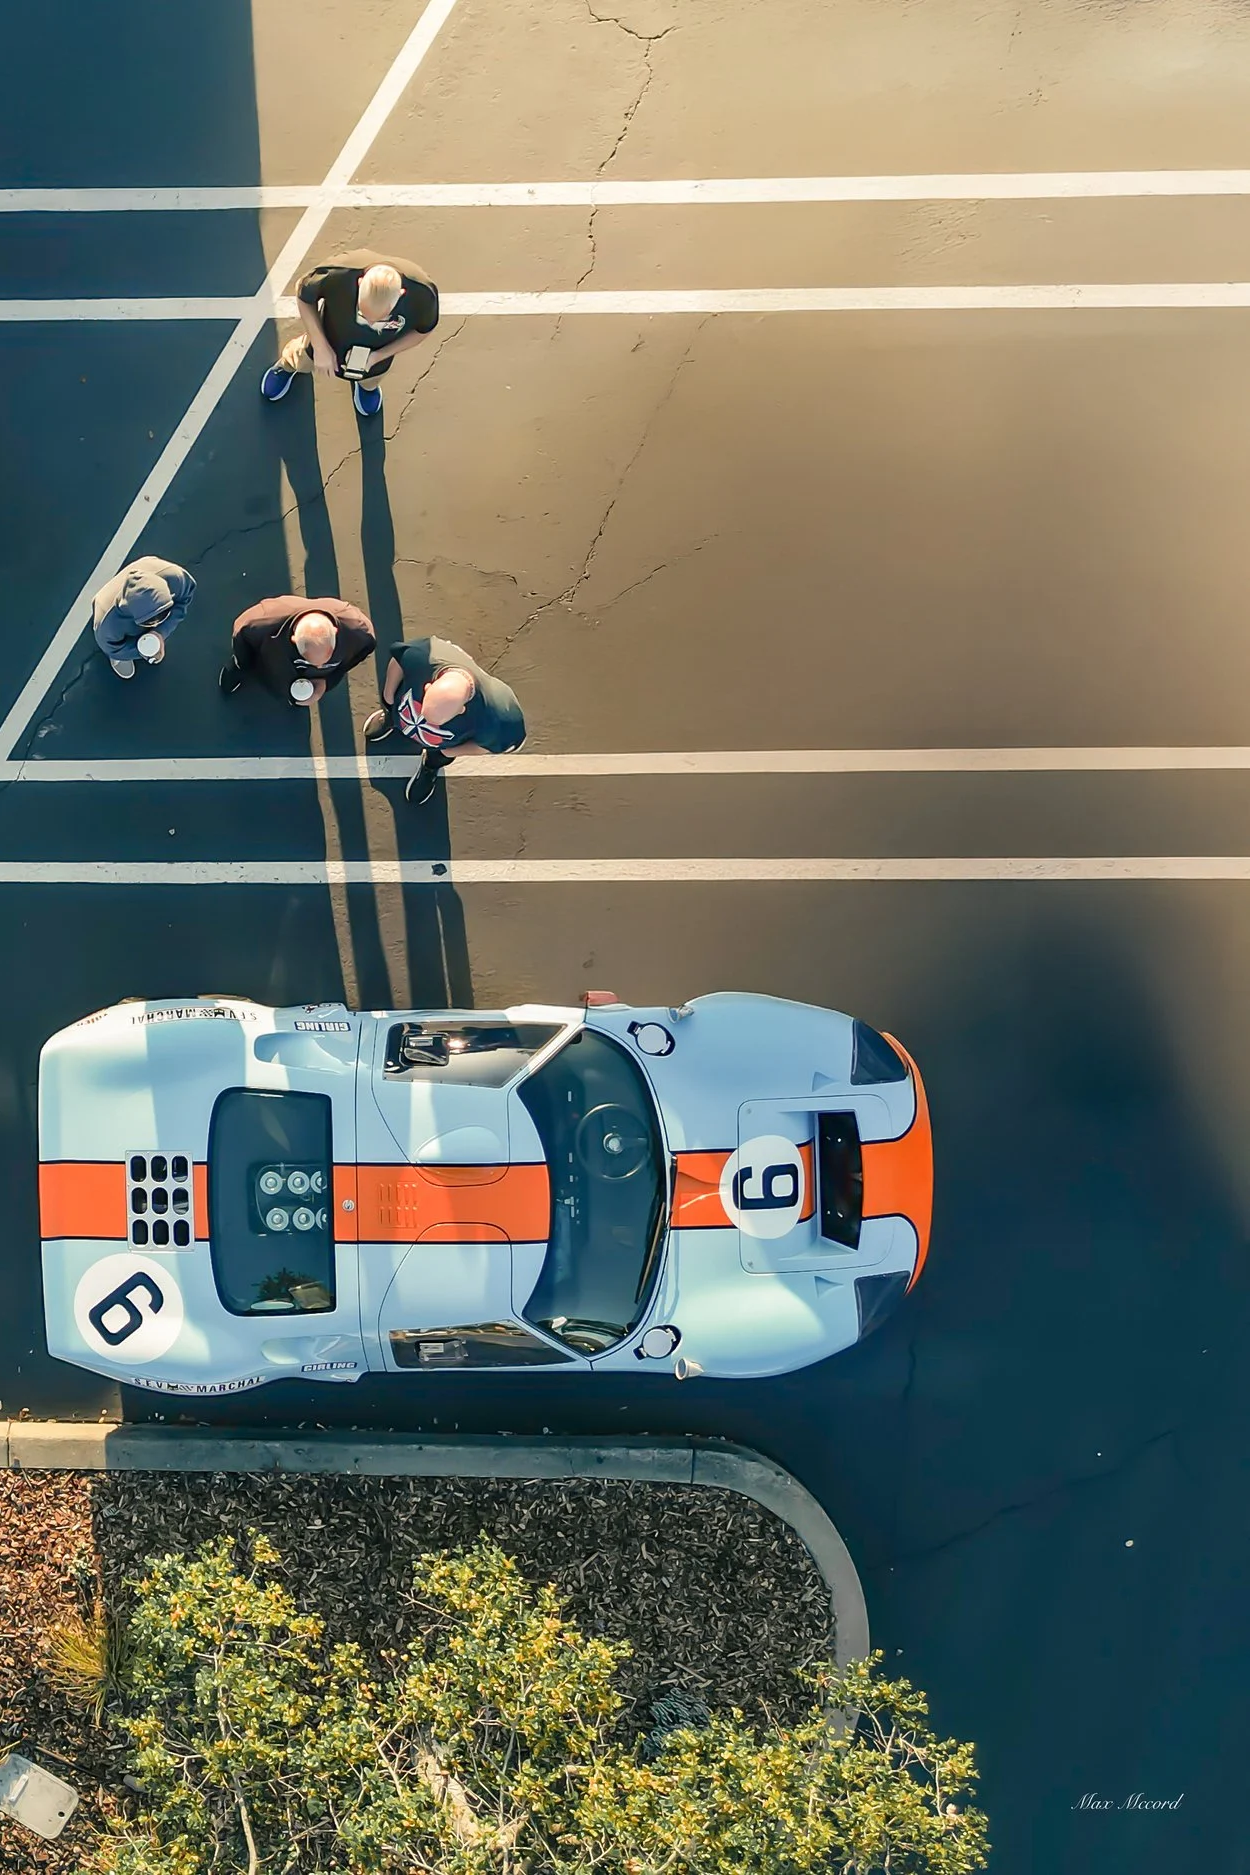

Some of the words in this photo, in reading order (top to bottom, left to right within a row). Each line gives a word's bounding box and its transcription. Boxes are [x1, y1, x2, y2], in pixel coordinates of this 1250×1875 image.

[295, 1021, 350, 1032] GIRLING
[88, 1271, 164, 1346] 6
[302, 1362, 357, 1372] GIRLING
